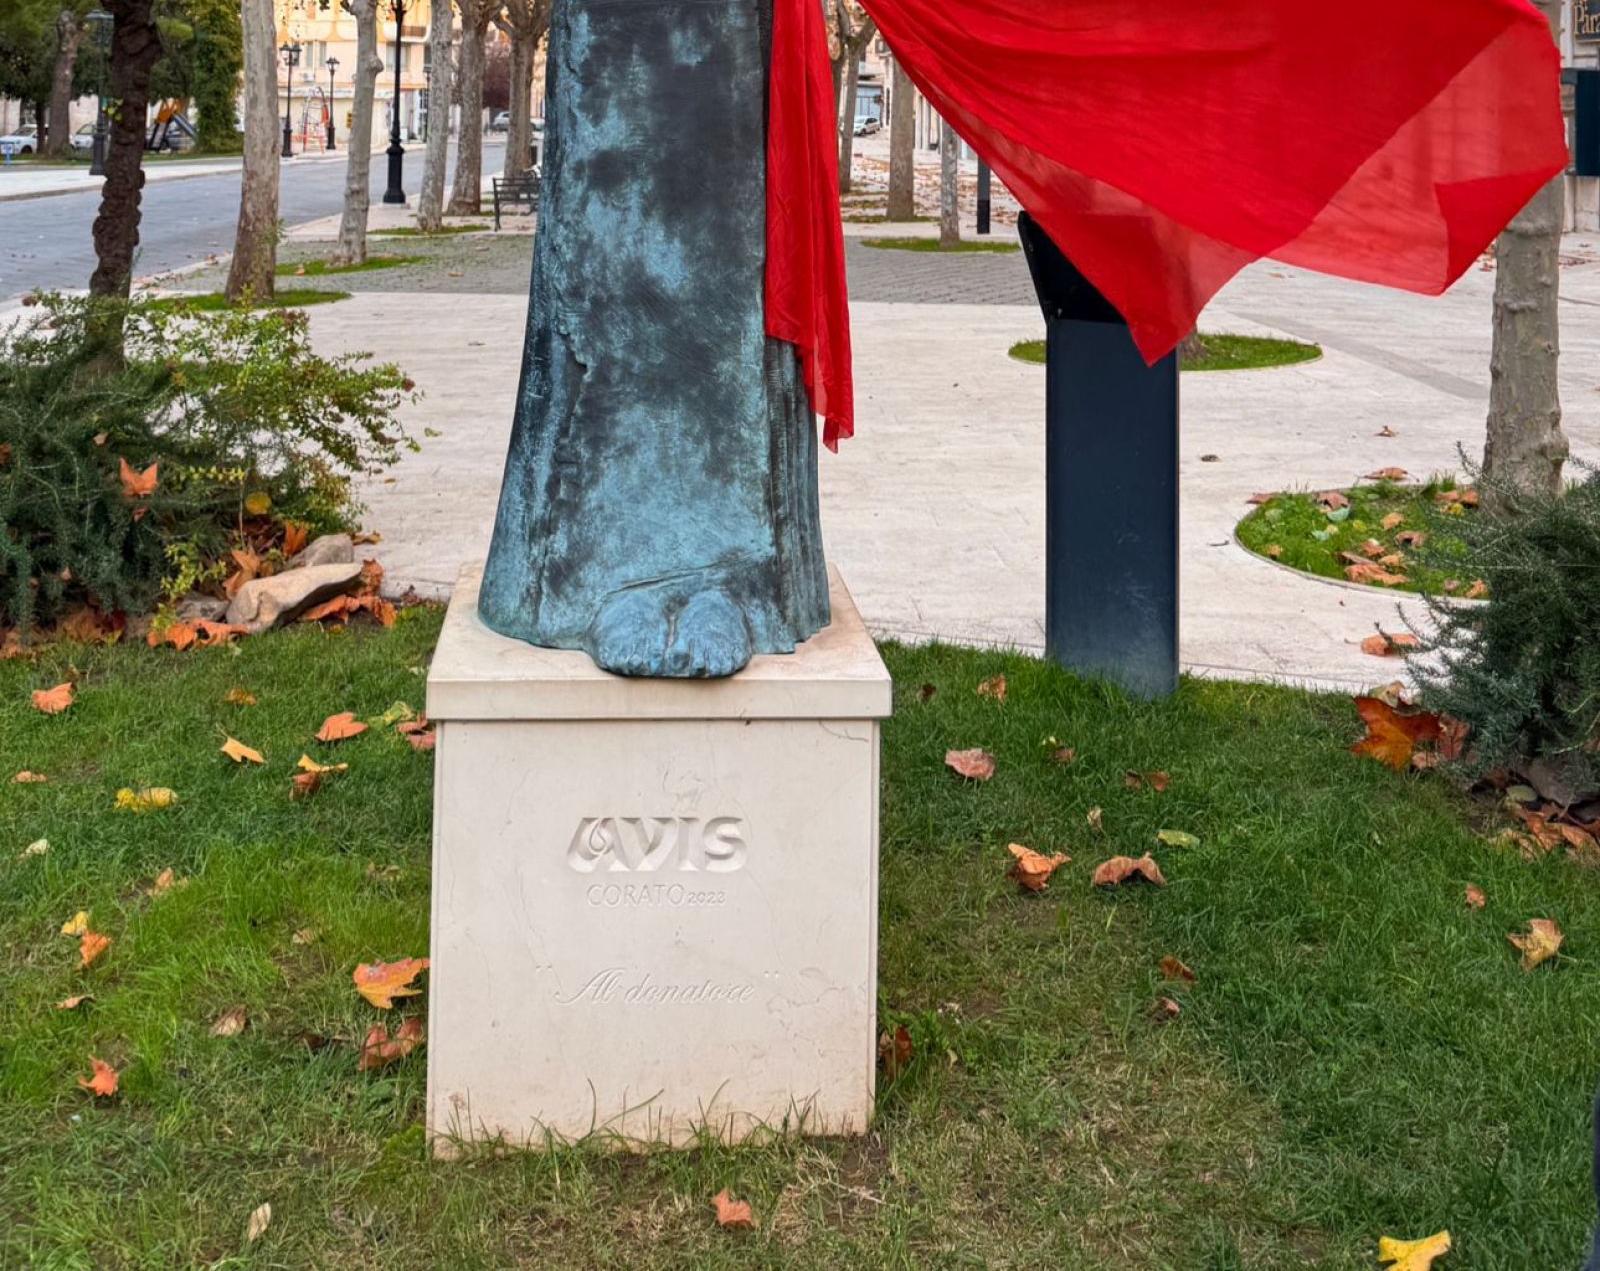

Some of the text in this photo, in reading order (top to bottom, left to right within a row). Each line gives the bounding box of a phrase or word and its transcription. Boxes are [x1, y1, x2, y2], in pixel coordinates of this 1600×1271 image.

[567, 816, 747, 872] AVIS
[586, 883, 727, 907] CORATO 2023
[554, 967, 755, 1005] Al donatore
